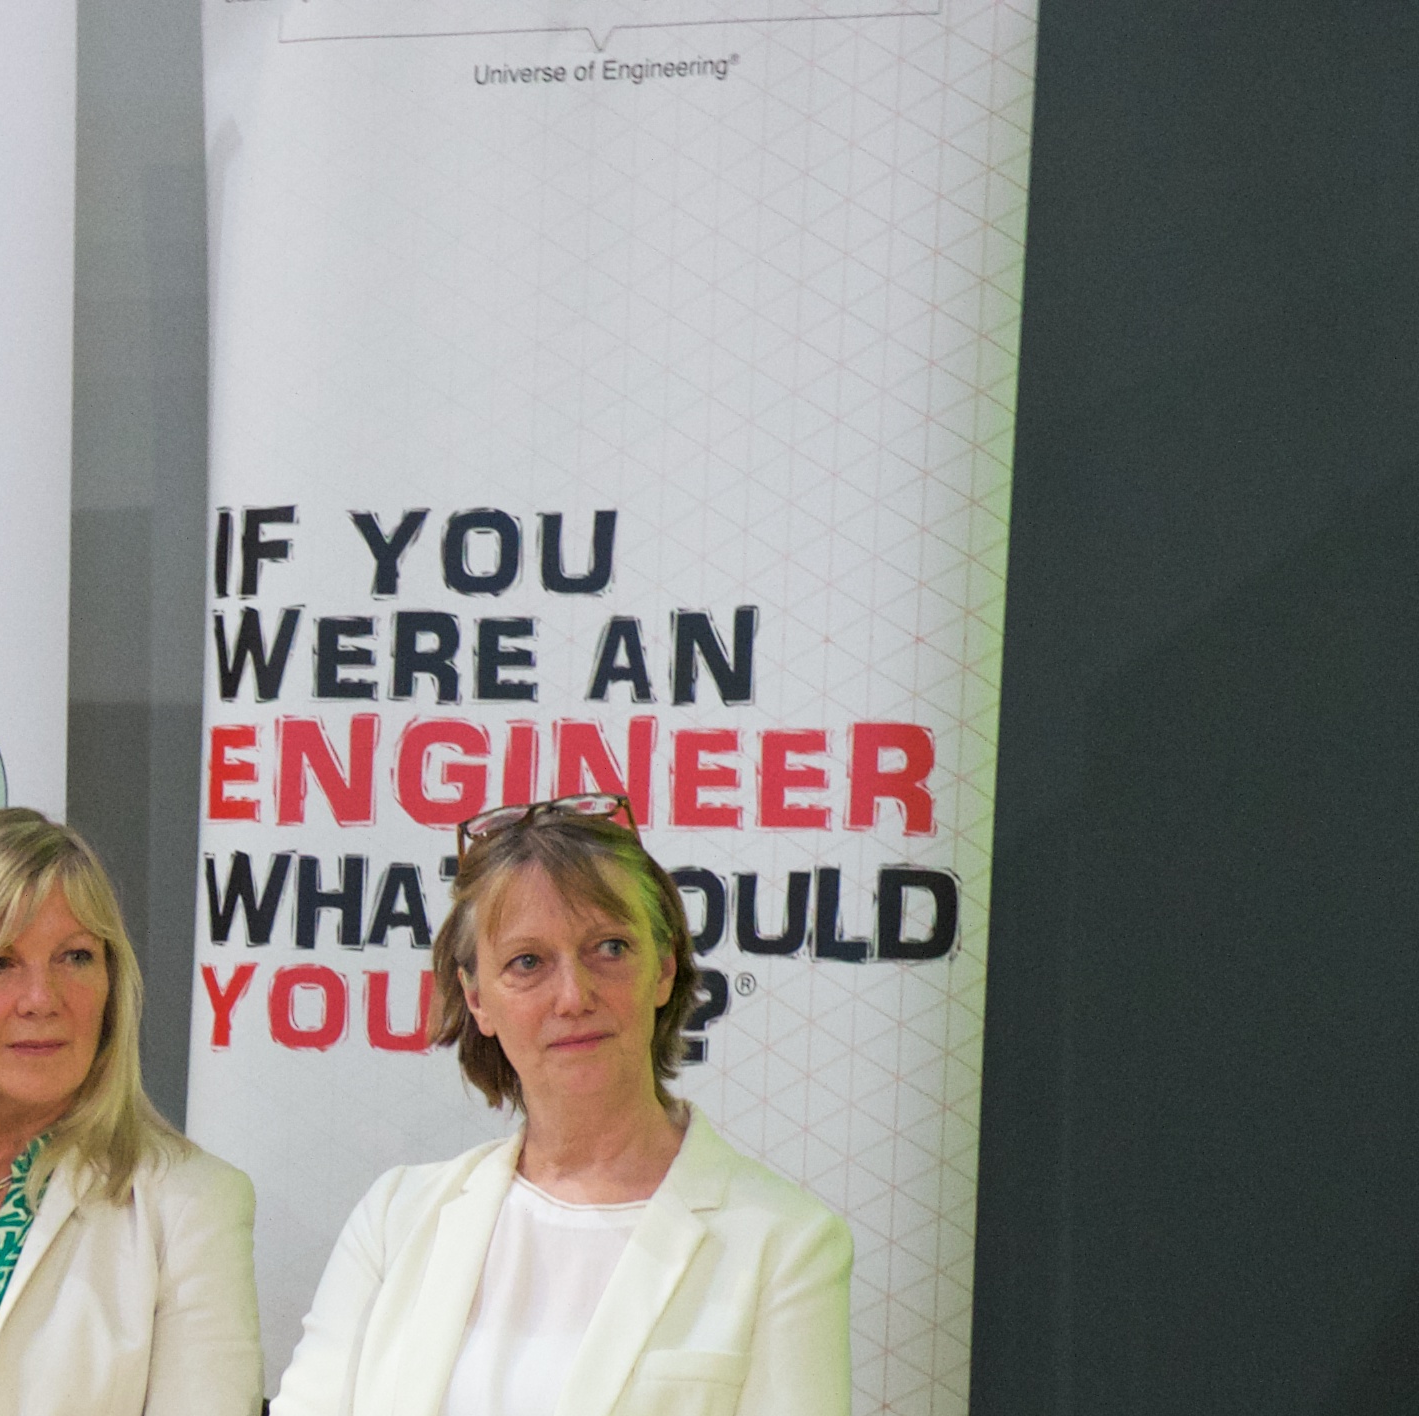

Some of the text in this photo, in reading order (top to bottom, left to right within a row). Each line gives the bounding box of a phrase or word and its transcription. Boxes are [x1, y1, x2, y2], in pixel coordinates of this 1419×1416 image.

[473, 64, 568, 86] Universe
[573, 60, 596, 82] of
[215, 505, 618, 600] IF YOU
[214, 605, 759, 707] WERE AN
[206, 712, 939, 837] ENGINEER
[204, 850, 962, 966] WHA OULD
[200, 961, 437, 1054] YOU
